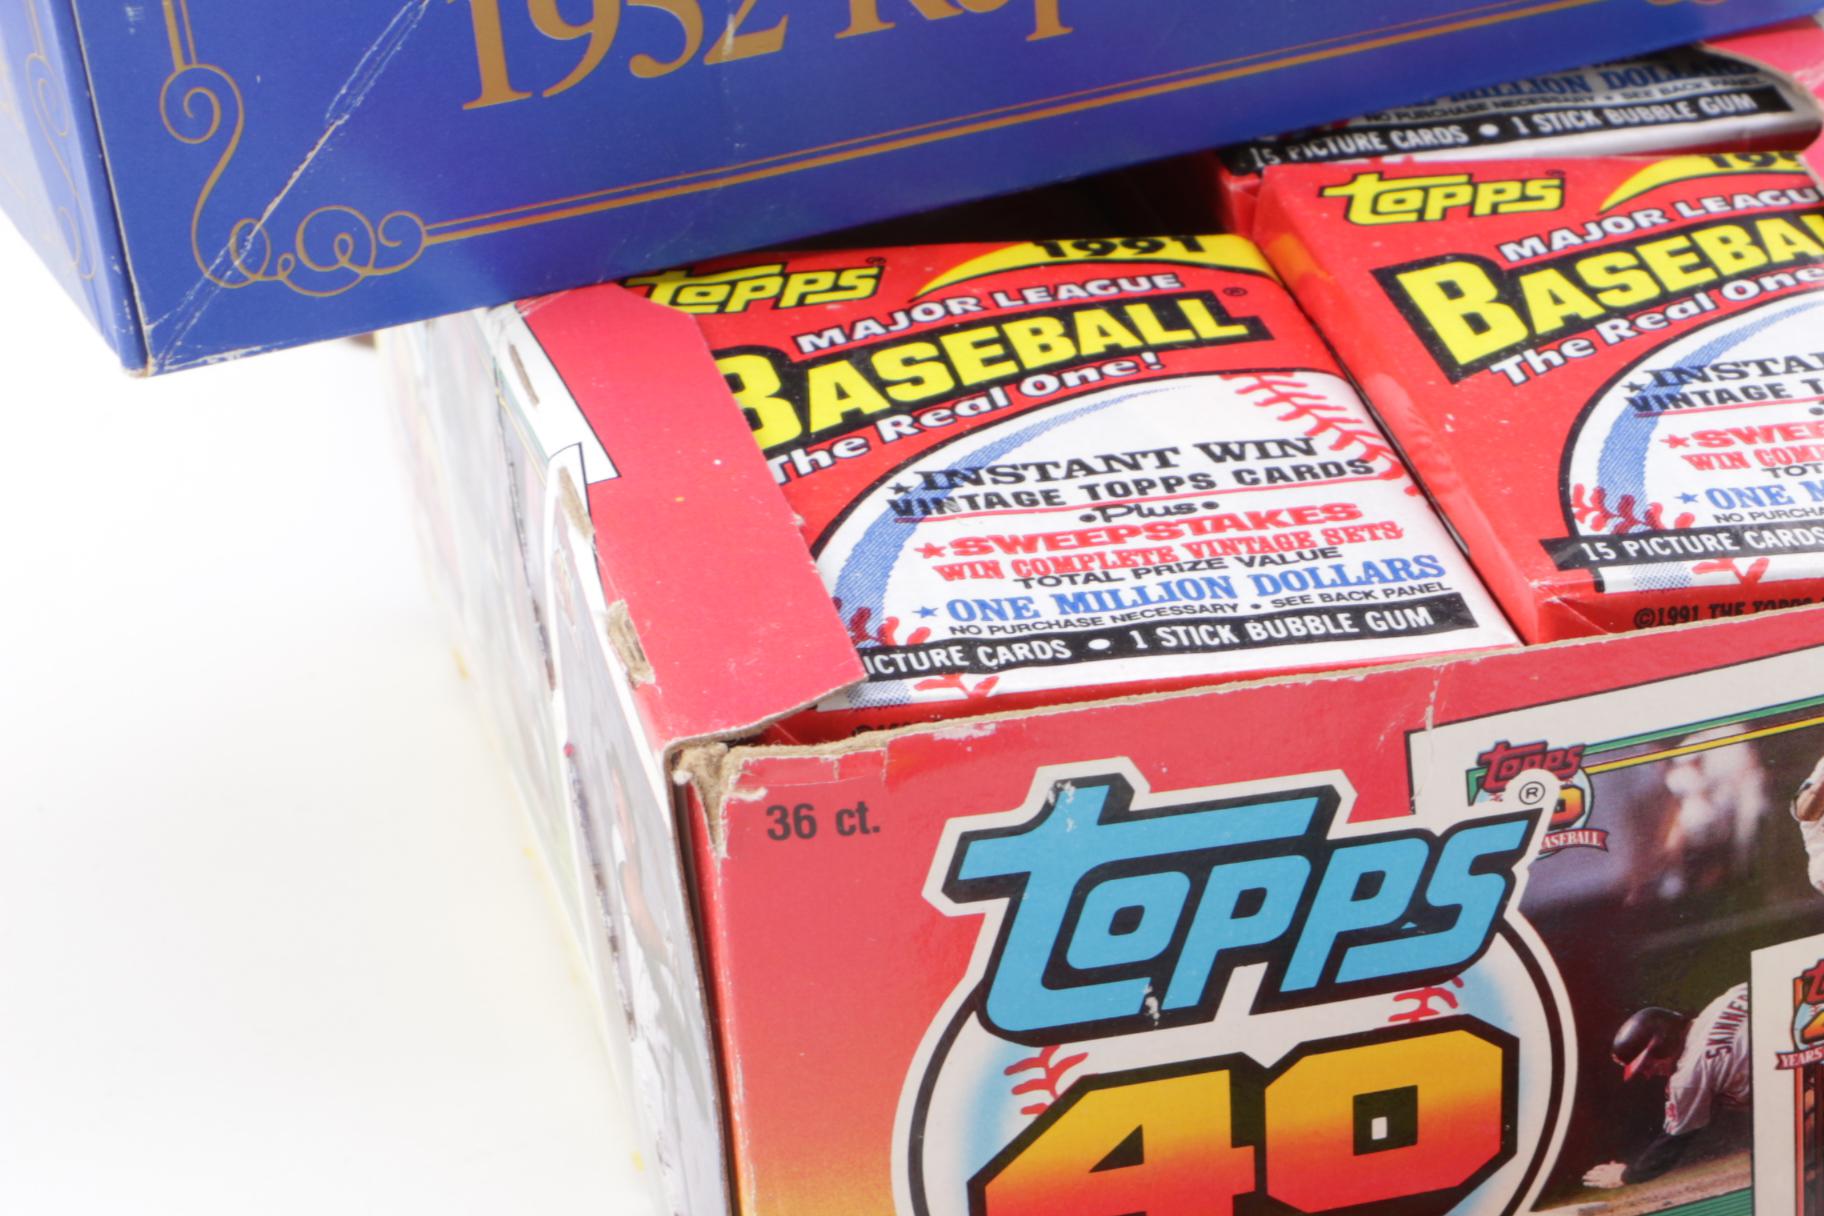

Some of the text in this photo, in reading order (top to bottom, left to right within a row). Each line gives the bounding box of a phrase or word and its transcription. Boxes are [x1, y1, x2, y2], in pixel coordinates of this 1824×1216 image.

[450, 0, 788, 109] 1952
[1394, 93, 1758, 148] CARDS STICK BUBBLE GUM
[1501, 187, 1821, 262] MAJOR LEAGU
[797, 272, 1179, 352] MAJOR LEAGUE
[1490, 337, 1595, 386] The
[1599, 292, 1714, 345] Real
[707, 296, 1248, 451] BASEBALL
[1627, 382, 1790, 413] VINTAGE
[769, 353, 1163, 486] The Real One!
[886, 458, 1375, 524] VINTAGE TOPPS CARDS
[914, 437, 1319, 492] INSTANT WIN
[1705, 484, 1792, 511] ONE
[933, 521, 1405, 583] WIN COMPLETE VINTAGE SETS
[949, 502, 1368, 557] SWEEPSTAKES
[1580, 543, 1615, 562] 15
[1622, 534, 1739, 558] PICTURE
[946, 554, 1446, 624] ONE MILLION DOLLARS
[1013, 545, 1343, 591] TOTAL PRIZE VALUE
[976, 605, 1436, 667] CARDS STICK BUBBLE GUM
[766, 800, 881, 842] 36 ct.
[1705, 992, 1749, 1060] SKINNE
[1776, 1048, 1821, 1070] YEARS
